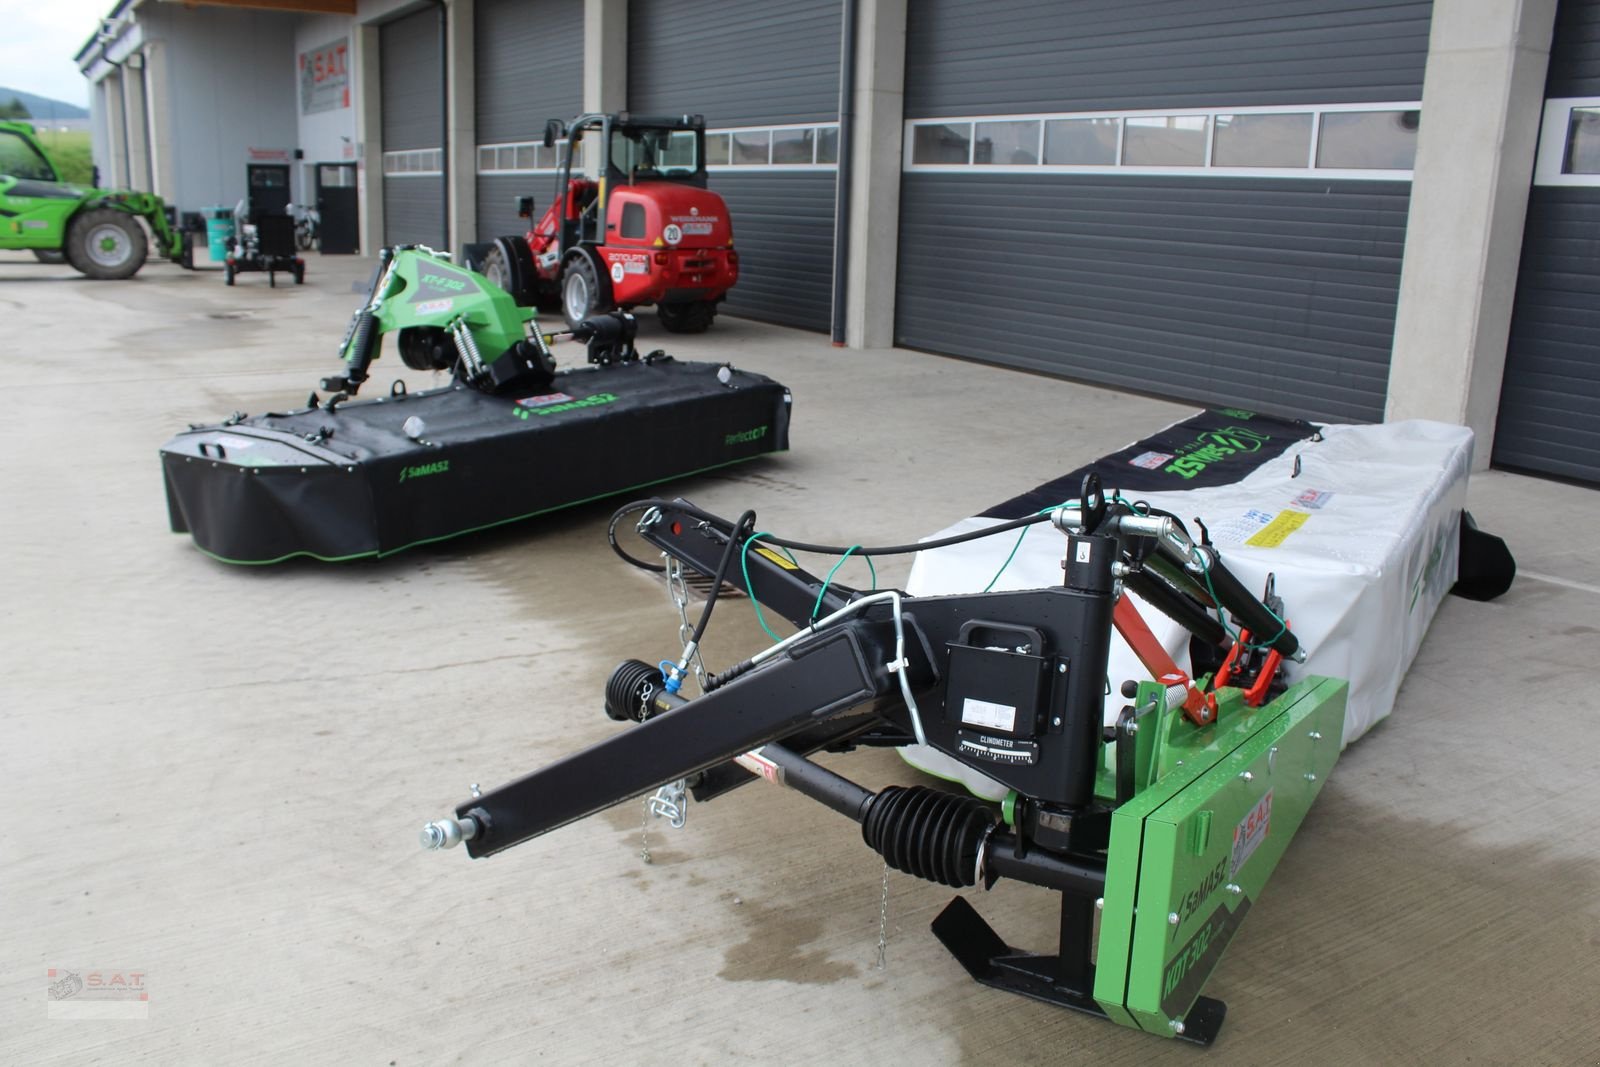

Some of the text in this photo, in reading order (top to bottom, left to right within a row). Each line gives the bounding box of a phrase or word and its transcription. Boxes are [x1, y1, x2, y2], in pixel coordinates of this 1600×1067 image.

[667, 226, 679, 241] 20
[980, 735, 1014, 748] CLINOMETER
[1188, 922, 1212, 970] 302
